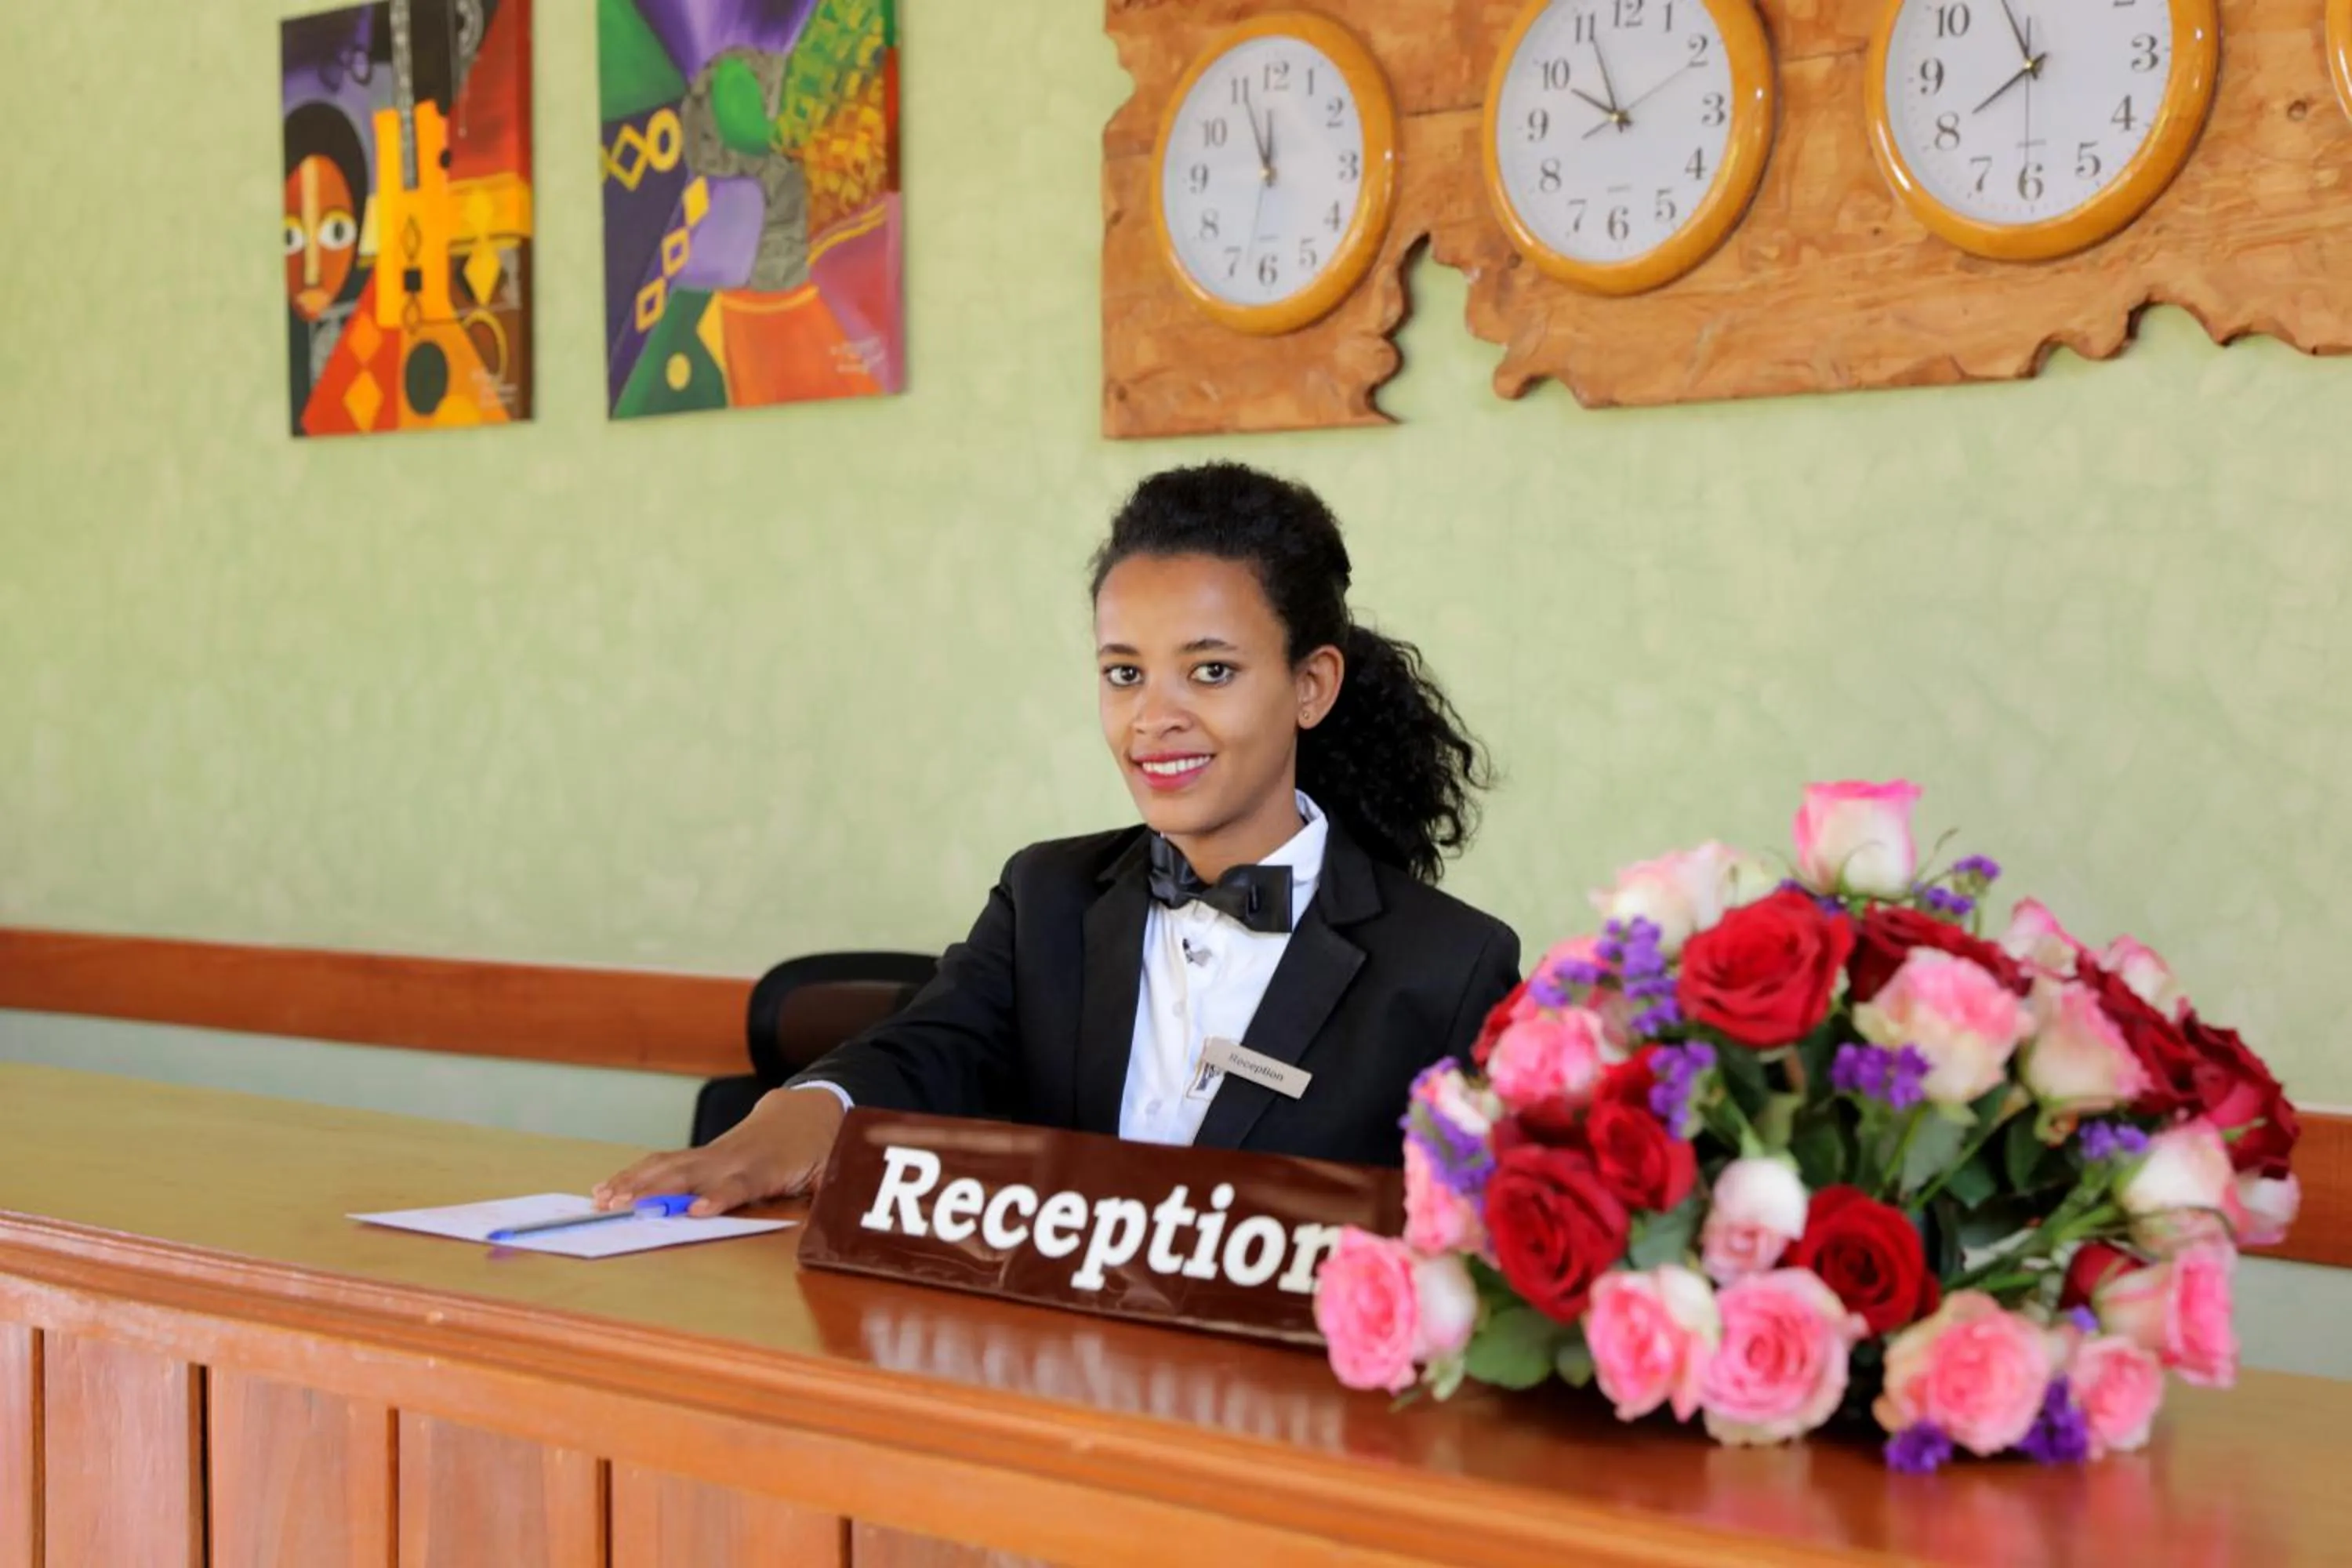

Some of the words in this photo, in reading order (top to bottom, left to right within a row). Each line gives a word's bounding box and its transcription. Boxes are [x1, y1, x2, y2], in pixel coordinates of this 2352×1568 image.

[1573, 13, 1595, 42] 11
[1613, 0, 1643, 28] 12
[1664, 2, 1673, 32] 1
[1935, 4, 1969, 38] 10
[1689, 35, 1708, 67] 2
[2131, 33, 2158, 72] 3
[1231, 76, 1250, 104] 11
[1263, 60, 1290, 92] 12
[1305, 67, 1314, 96] 1
[1542, 58, 1570, 91] 10
[1920, 58, 1944, 95] 9
[1327, 97, 1343, 129] 2
[1702, 92, 1726, 126] 3
[2111, 95, 2137, 131] 4
[1203, 118, 1227, 147] 10
[1528, 109, 1548, 142] 9
[1935, 111, 1960, 151] 8
[1339, 151, 1358, 181] 3
[1540, 158, 1561, 193] 8
[1685, 147, 1707, 180] 4
[1969, 157, 1992, 193] 7
[2075, 142, 2101, 179] 5
[1190, 163, 1208, 194] 9
[2018, 163, 2044, 201] 6
[1323, 201, 1341, 231] 4
[1568, 198, 1588, 233] 7
[1656, 188, 1676, 222] 5
[1200, 209, 1219, 240] 8
[1607, 207, 1629, 241] 6
[1225, 246, 1241, 278] 7
[1300, 238, 1317, 268] 5
[1259, 255, 1278, 285] 6
[1229, 1053, 1284, 1082] Reception
